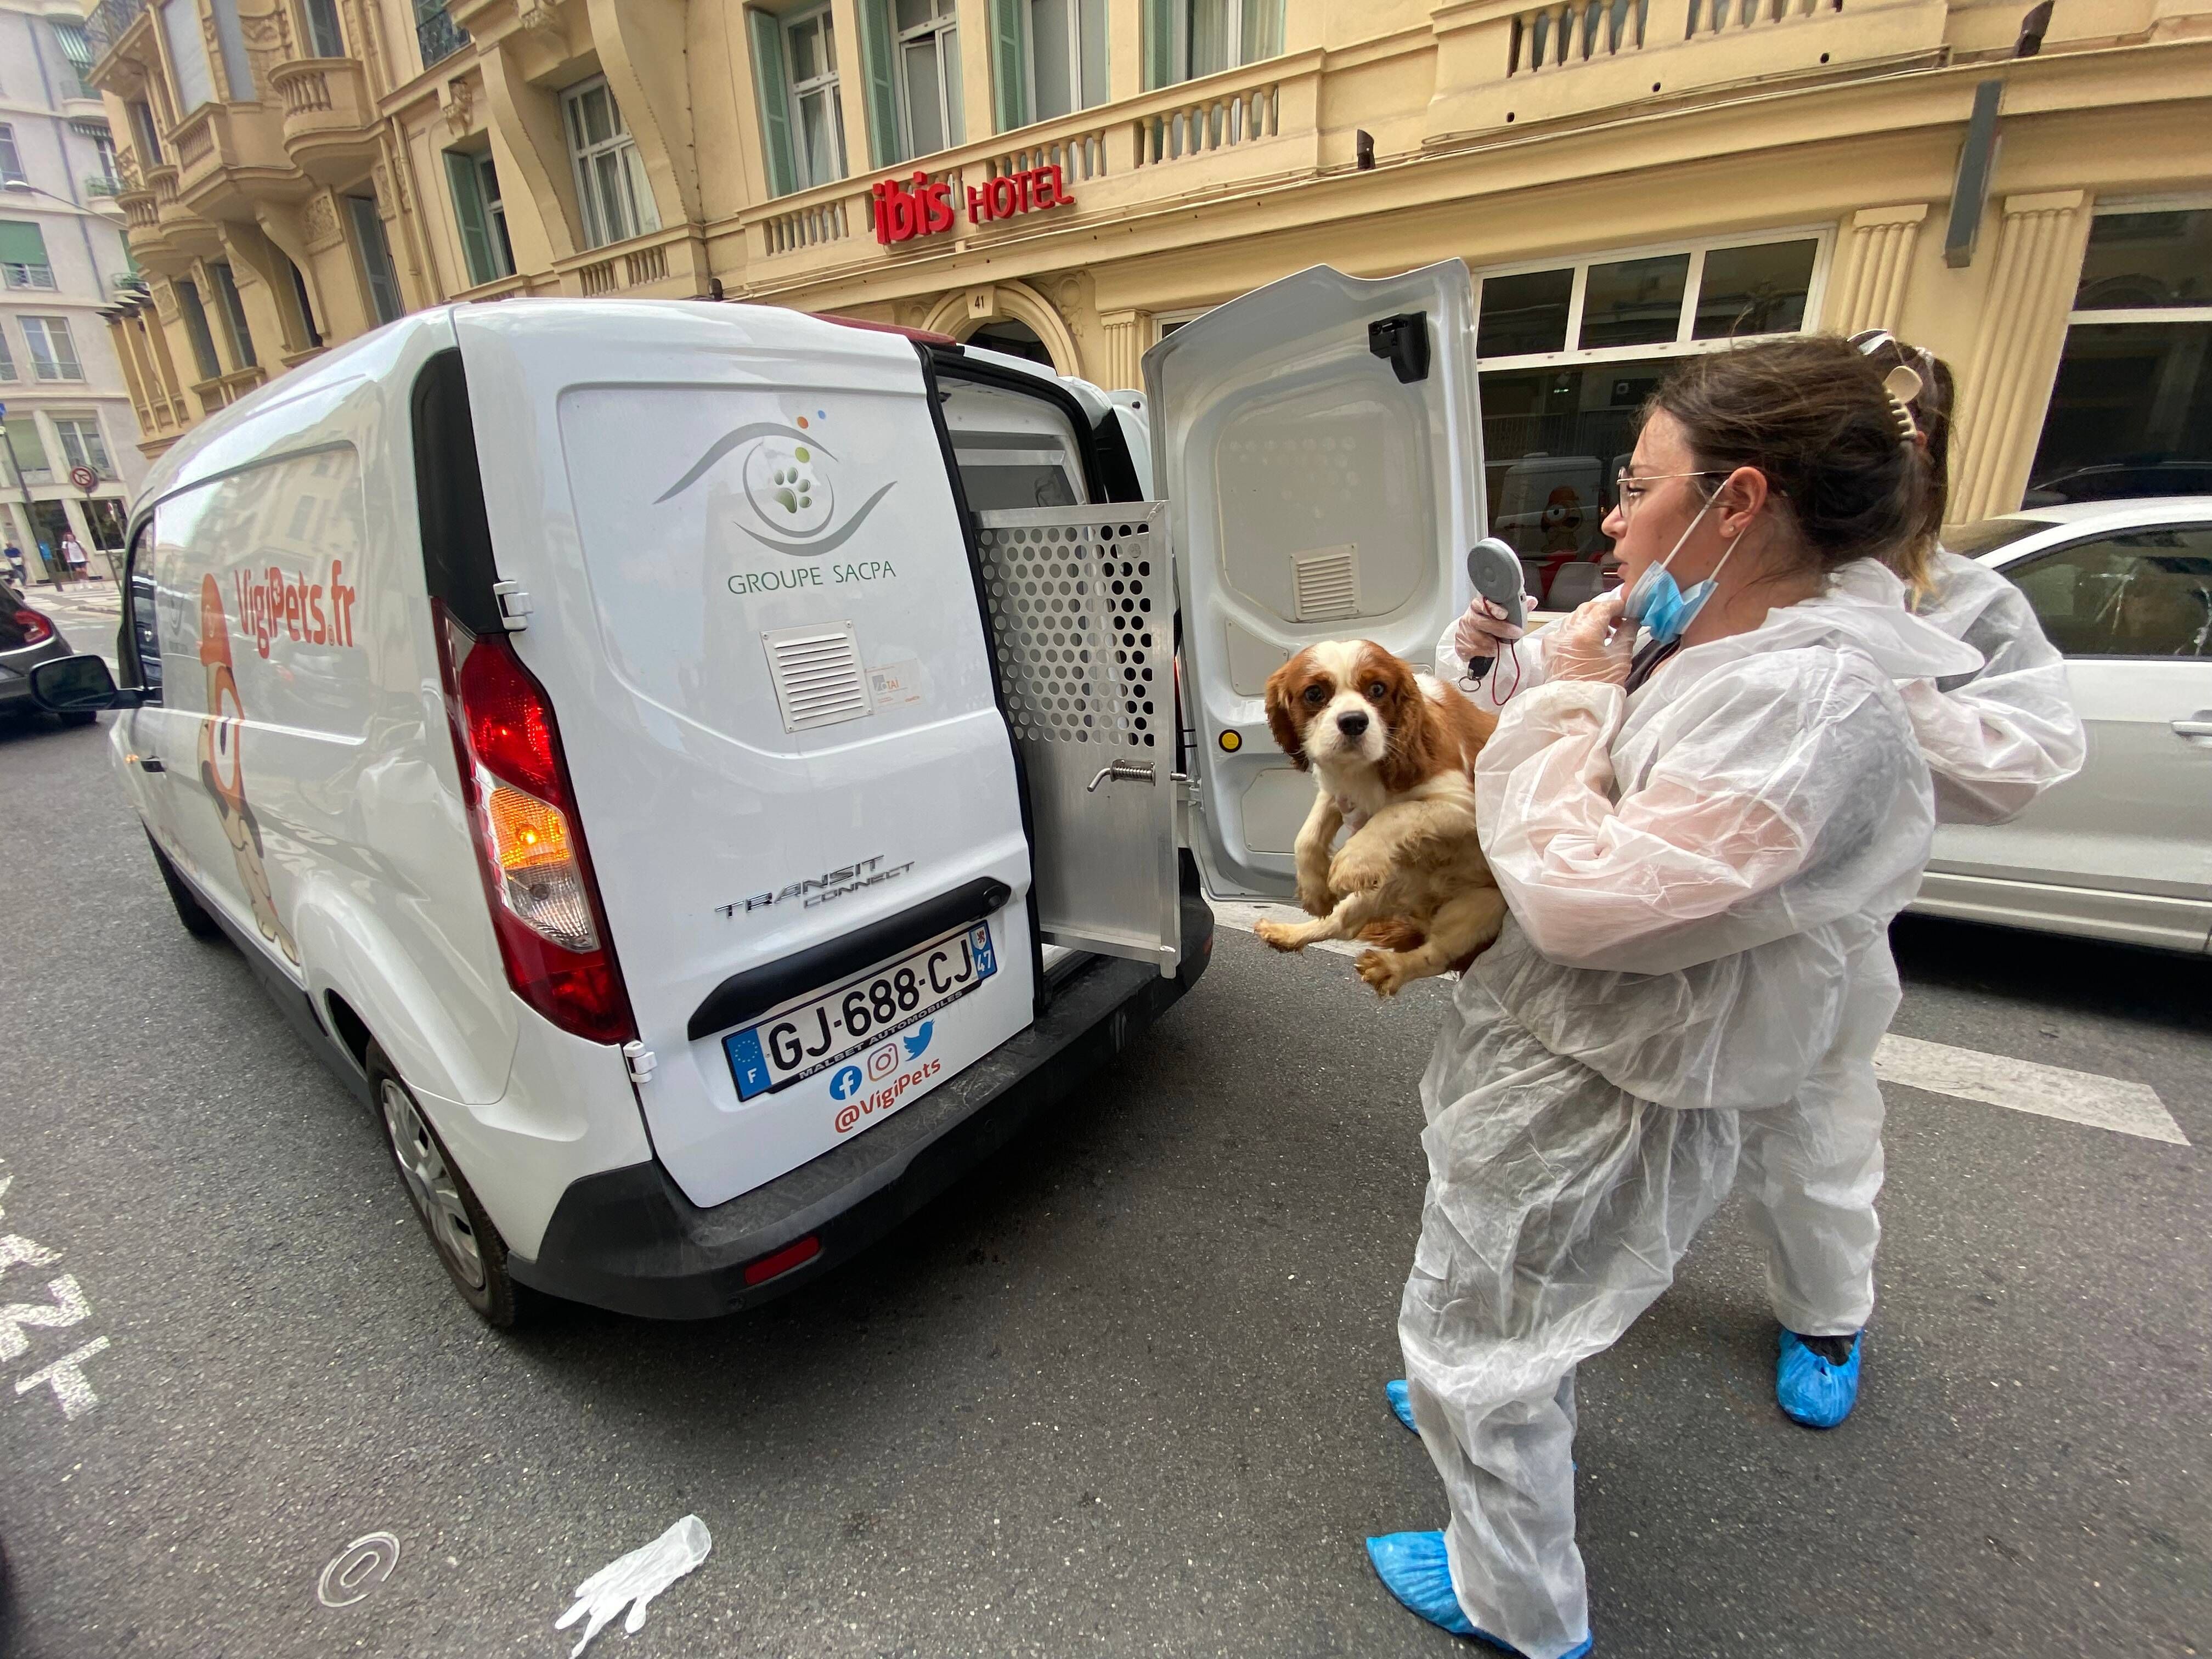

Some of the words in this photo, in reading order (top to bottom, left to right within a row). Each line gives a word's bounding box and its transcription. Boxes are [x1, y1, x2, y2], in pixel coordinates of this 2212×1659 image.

[872, 171, 954, 245] ibis
[967, 163, 1075, 224] HOTEL
[974, 295, 985, 309] 41
[235, 560, 356, 659] VigiPets.fr
[728, 566, 823, 594] GROUPE
[833, 561, 896, 584] SACPA
[715, 854, 884, 918] TRANSIT
[804, 861, 915, 909] CONNECT
[748, 1067, 757, 1084] F
[769, 939, 973, 1071] GJ-688-CJ
[977, 950, 991, 972] 47
[799, 1043, 865, 1080] MALBET
[869, 991, 963, 1047] AUTOMOBILES
[834, 1056, 941, 1132] @VigiPets
